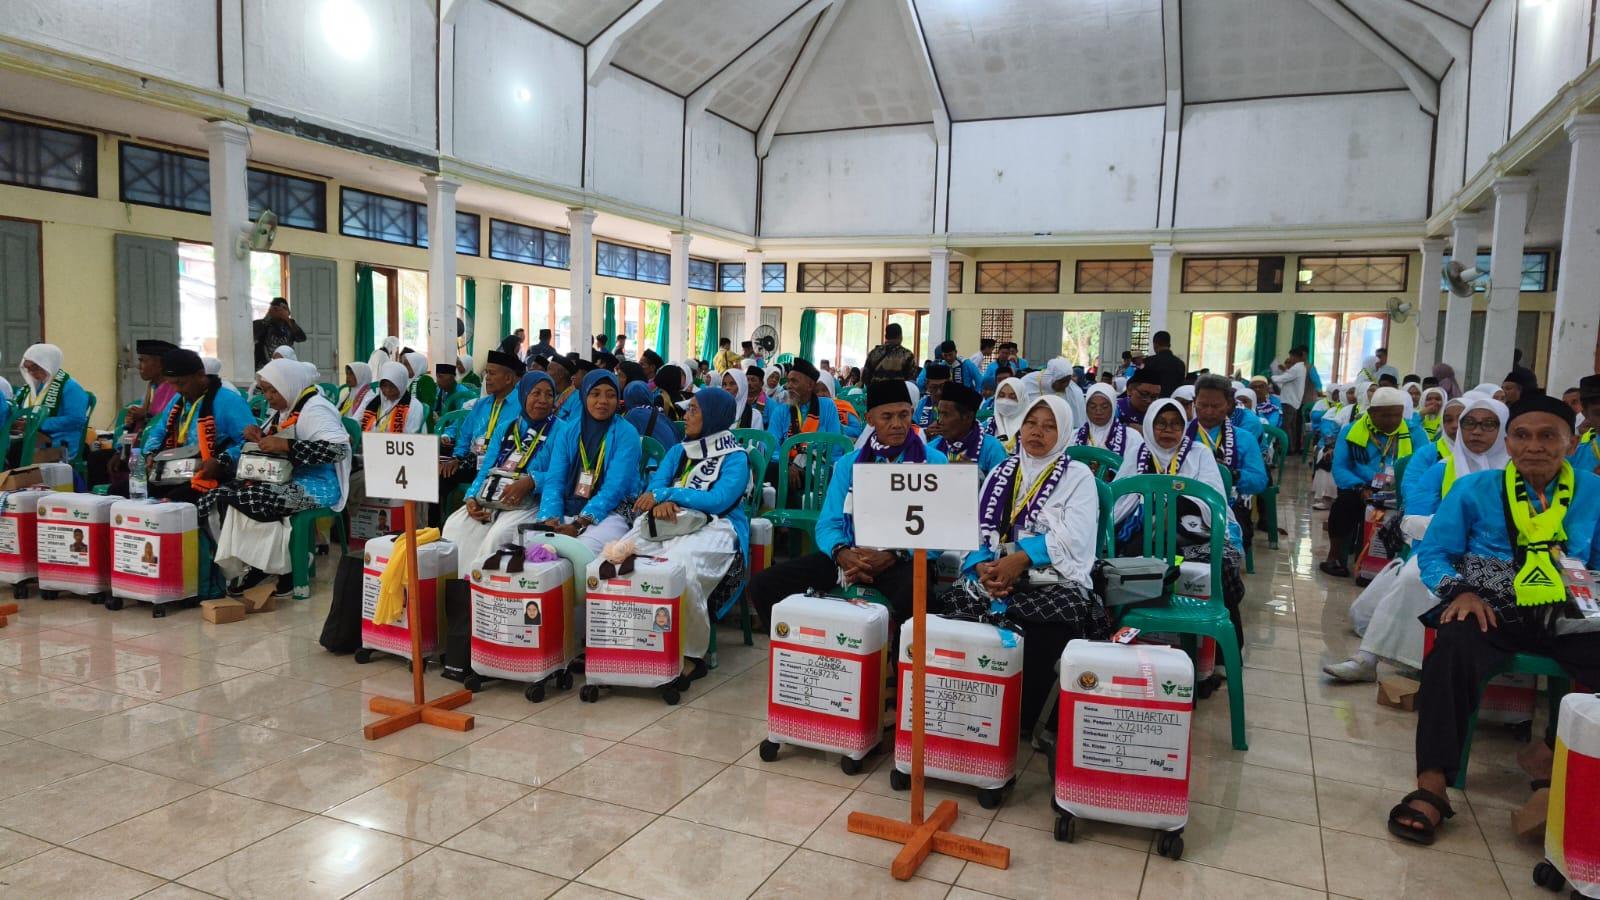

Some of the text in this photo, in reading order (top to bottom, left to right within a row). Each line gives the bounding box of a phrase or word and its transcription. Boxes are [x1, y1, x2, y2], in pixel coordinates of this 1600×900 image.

[386, 441, 415, 456] BUS
[395, 465, 408, 489] 4
[890, 473, 939, 492] BUS
[905, 505, 925, 536] 5
[937, 702, 955, 711] KJT
[937, 711, 946, 720] 21
[1114, 709, 1179, 723] TITA HARTATI
[938, 722, 943, 731] 5
[1116, 724, 1163, 735] X7211443
[1115, 734, 1134, 744] KJT
[1116, 746, 1126, 756] 21
[1116, 757, 1124, 767] 5
